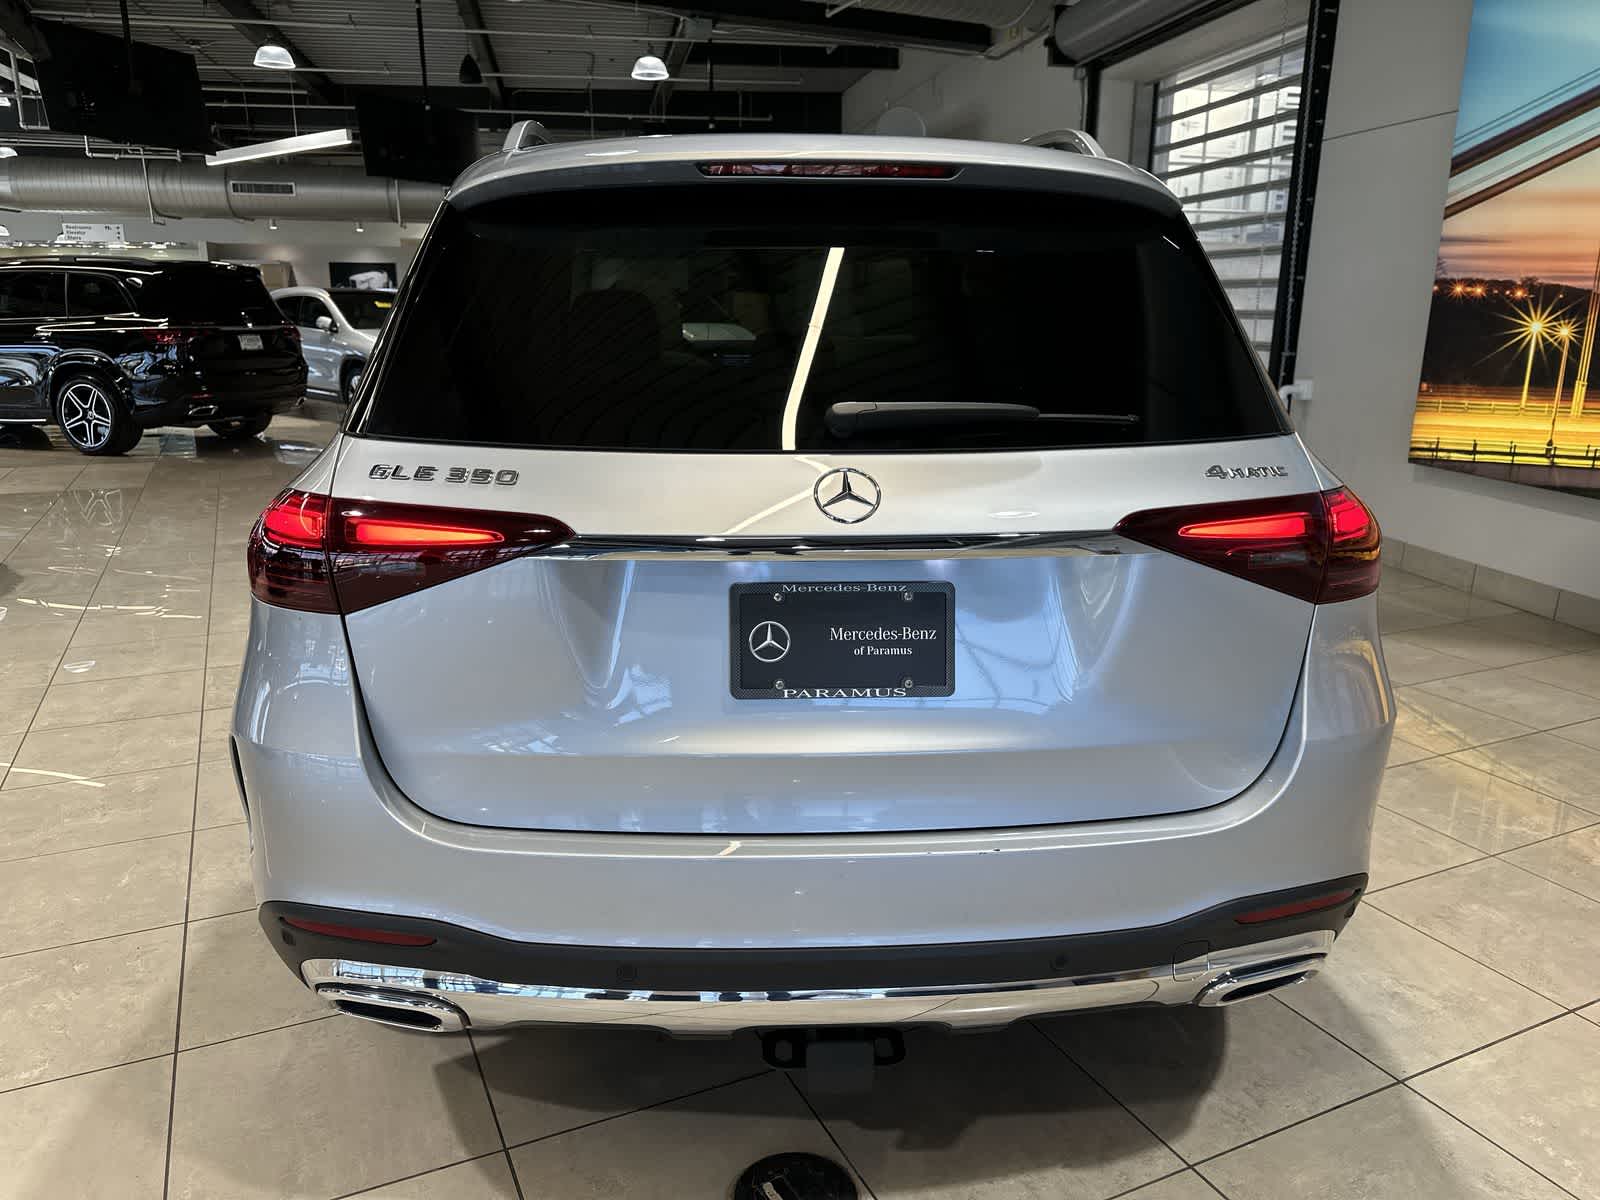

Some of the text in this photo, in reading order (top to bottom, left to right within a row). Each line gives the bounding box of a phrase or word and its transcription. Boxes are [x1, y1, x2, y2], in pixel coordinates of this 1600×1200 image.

[369, 464, 520, 486] GLE 350
[1204, 464, 1289, 479] 4MATIC
[781, 583, 908, 593] Mercedes-Benz
[829, 626, 937, 641] Mercedes-Benz
[853, 645, 913, 656] of Paramus
[782, 687, 907, 699] PARAMUS
